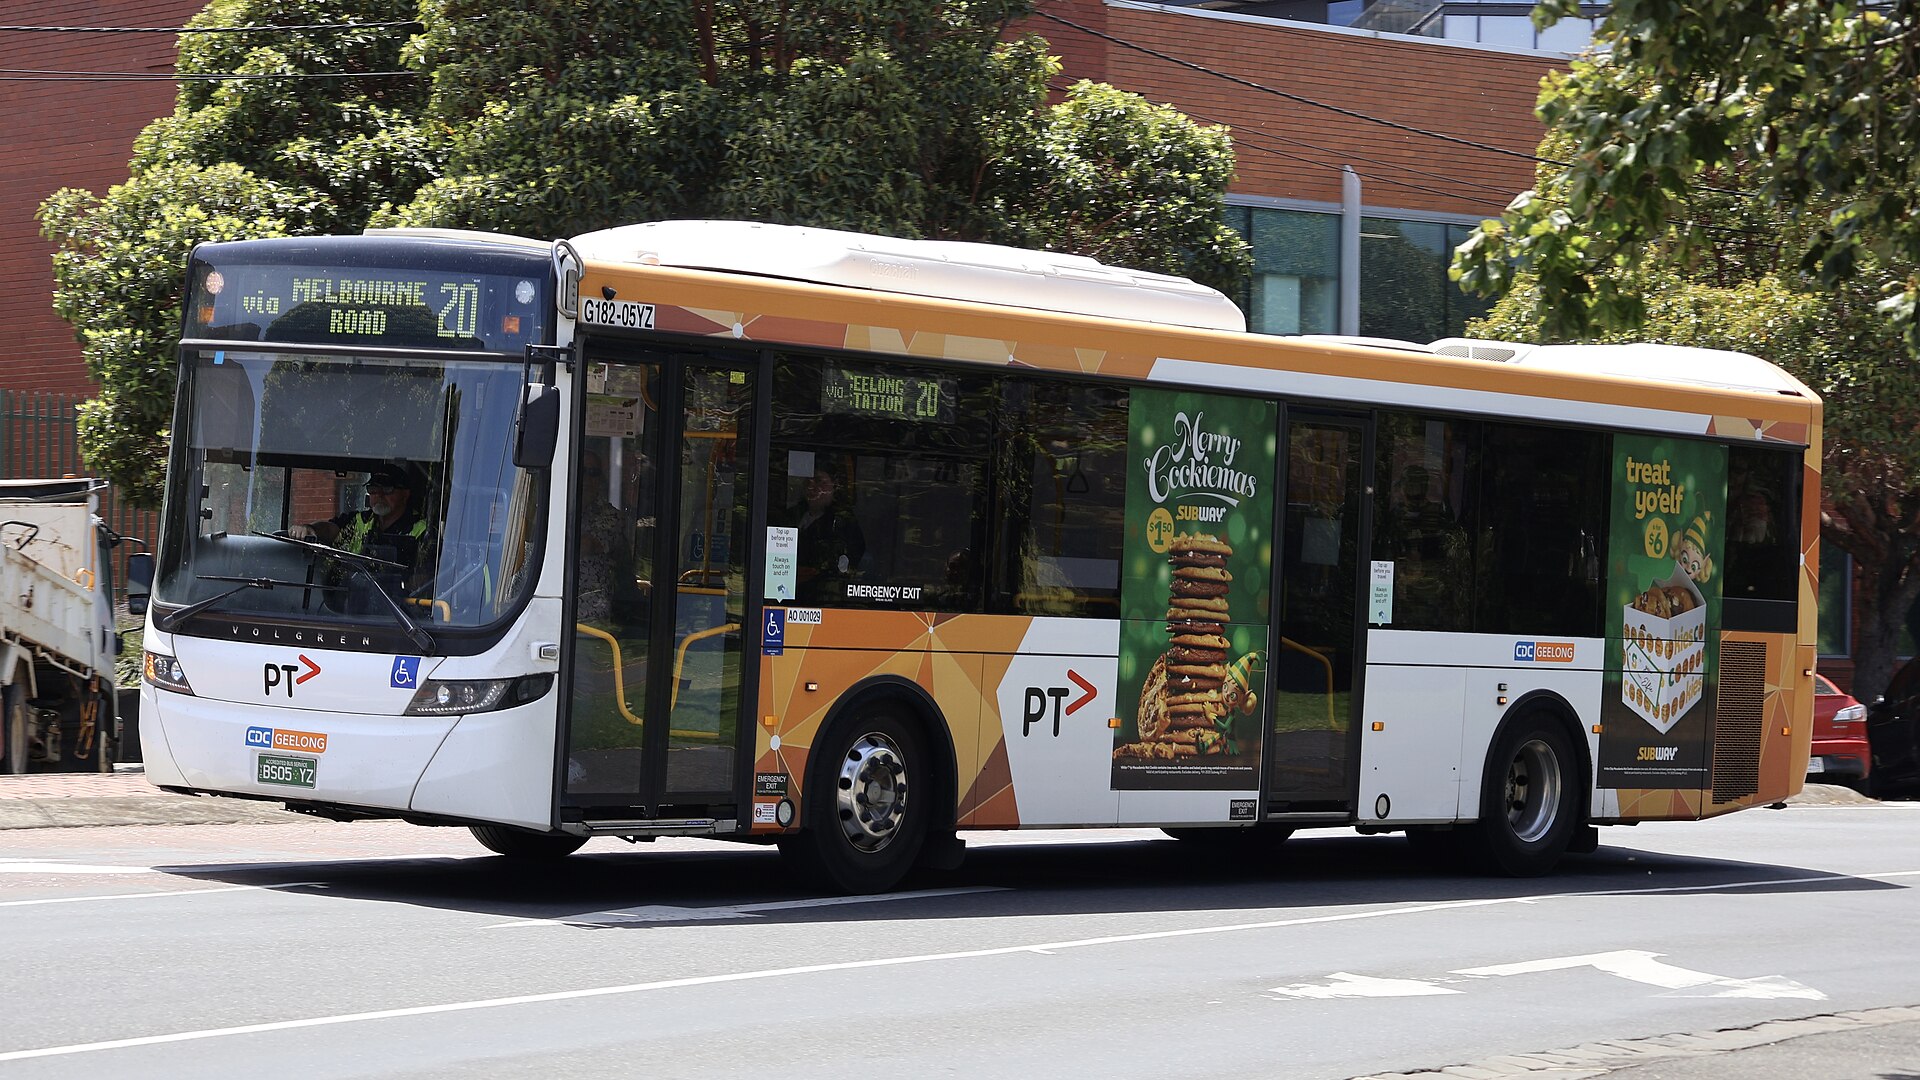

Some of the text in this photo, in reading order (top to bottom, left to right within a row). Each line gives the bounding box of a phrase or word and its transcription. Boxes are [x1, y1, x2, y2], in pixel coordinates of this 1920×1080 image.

[243, 290, 280, 315] via
[292, 278, 478, 339] MELBOURNE 20
[330, 309, 387, 335] ROAD
[584, 300, 654, 328] G182-05YZ
[826, 382, 844, 399] via
[916, 381, 939, 417] 20
[1171, 411, 1241, 466] Merry
[1144, 445, 1257, 503] Cookiemas
[1626, 456, 1671, 485] treat
[1635, 485, 1684, 519] yo'elf
[1176, 505, 1227, 522] SUBWAY
[1649, 531, 1663, 555] $6
[774, 556, 789, 564] Always
[847, 584, 922, 600] EMERGENCY EXIT
[788, 610, 821, 622] AO 001029
[1516, 645, 1573, 658] CDC GEELONG
[247, 729, 325, 750] CDC GEELONG
[1636, 746, 1679, 761] SUBWAY
[263, 764, 314, 784] BS05 YZ
[757, 775, 787, 783] EMERGENCY
